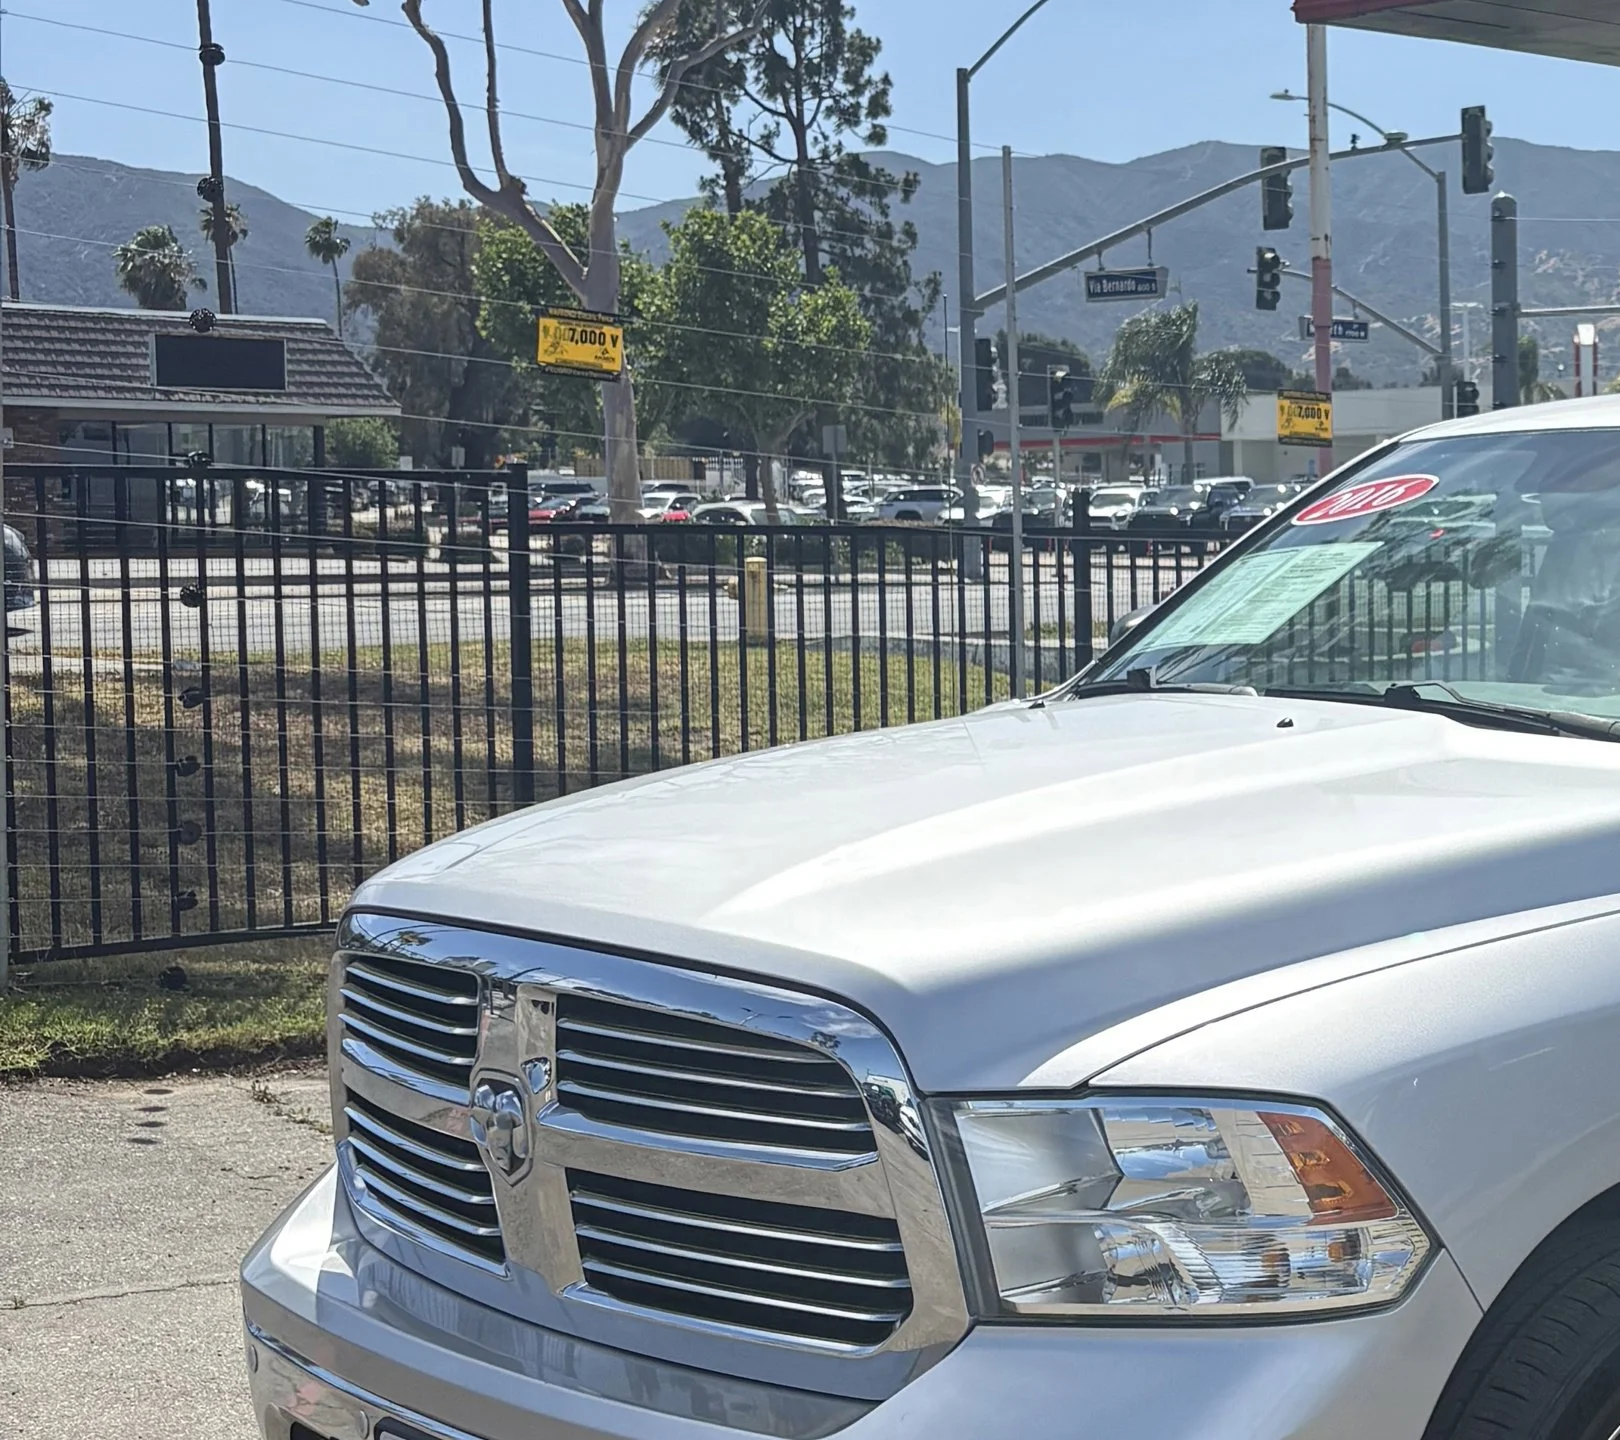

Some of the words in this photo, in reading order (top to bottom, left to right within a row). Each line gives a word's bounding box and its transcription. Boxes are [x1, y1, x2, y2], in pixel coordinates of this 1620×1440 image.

[1102, 278, 1136, 293] Bernardo
[568, 327, 606, 346] 7,000
[611, 334, 619, 348] V
[1297, 406, 1322, 420] 7,000
[1303, 479, 1427, 521] 2016
